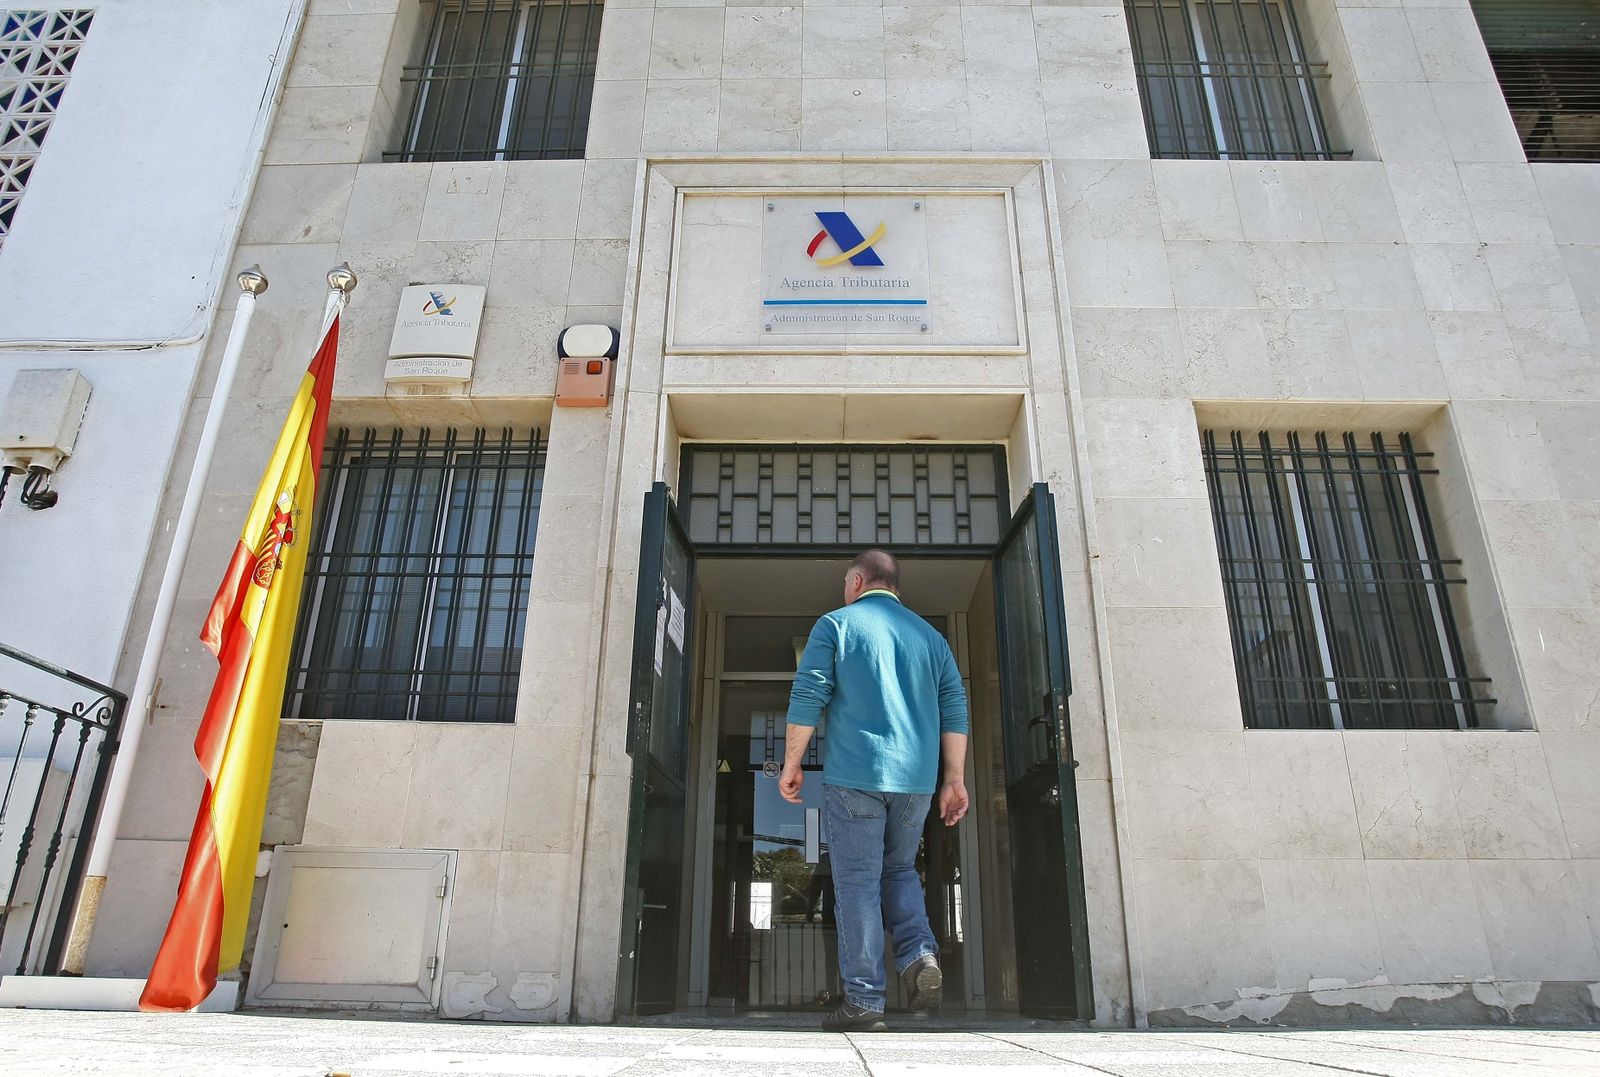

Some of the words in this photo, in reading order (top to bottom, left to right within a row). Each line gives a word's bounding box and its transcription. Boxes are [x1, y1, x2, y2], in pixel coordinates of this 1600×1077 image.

[780, 277, 834, 291] Agencia
[838, 276, 910, 288] Tributaria
[771, 313, 848, 322] Administración
[851, 313, 863, 322] de
[866, 313, 885, 322] San
[888, 313, 920, 324] Roque
[401, 320, 431, 329] Agencia
[433, 319, 471, 328] Tributaria
[404, 367, 420, 375] San
[421, 367, 448, 375] Roque
